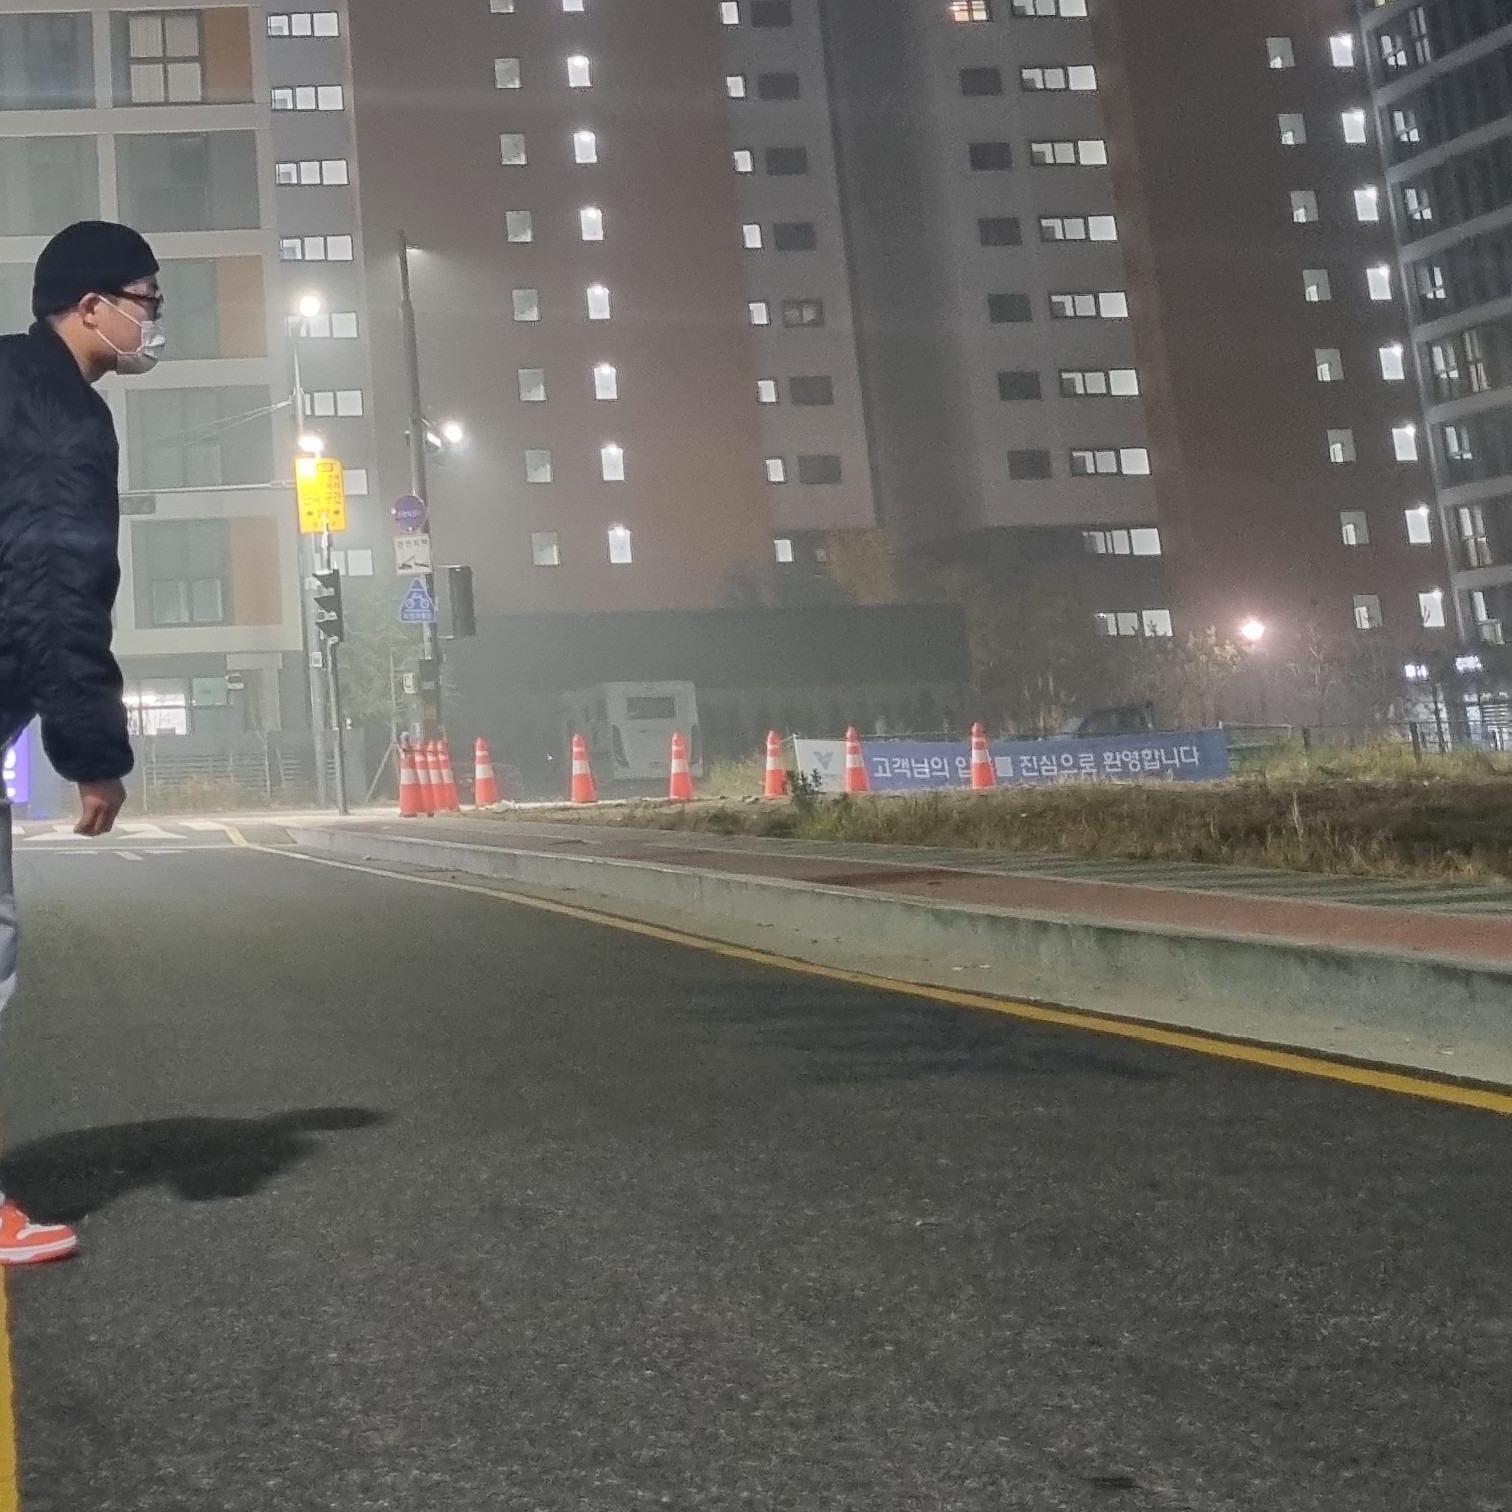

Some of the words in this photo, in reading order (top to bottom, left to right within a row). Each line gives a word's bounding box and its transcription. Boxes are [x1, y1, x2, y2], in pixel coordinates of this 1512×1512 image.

[873, 757, 950, 779] 고객님의
[1020, 753, 1098, 777] 진심으로
[1103, 745, 1200, 773] 환영합니다
